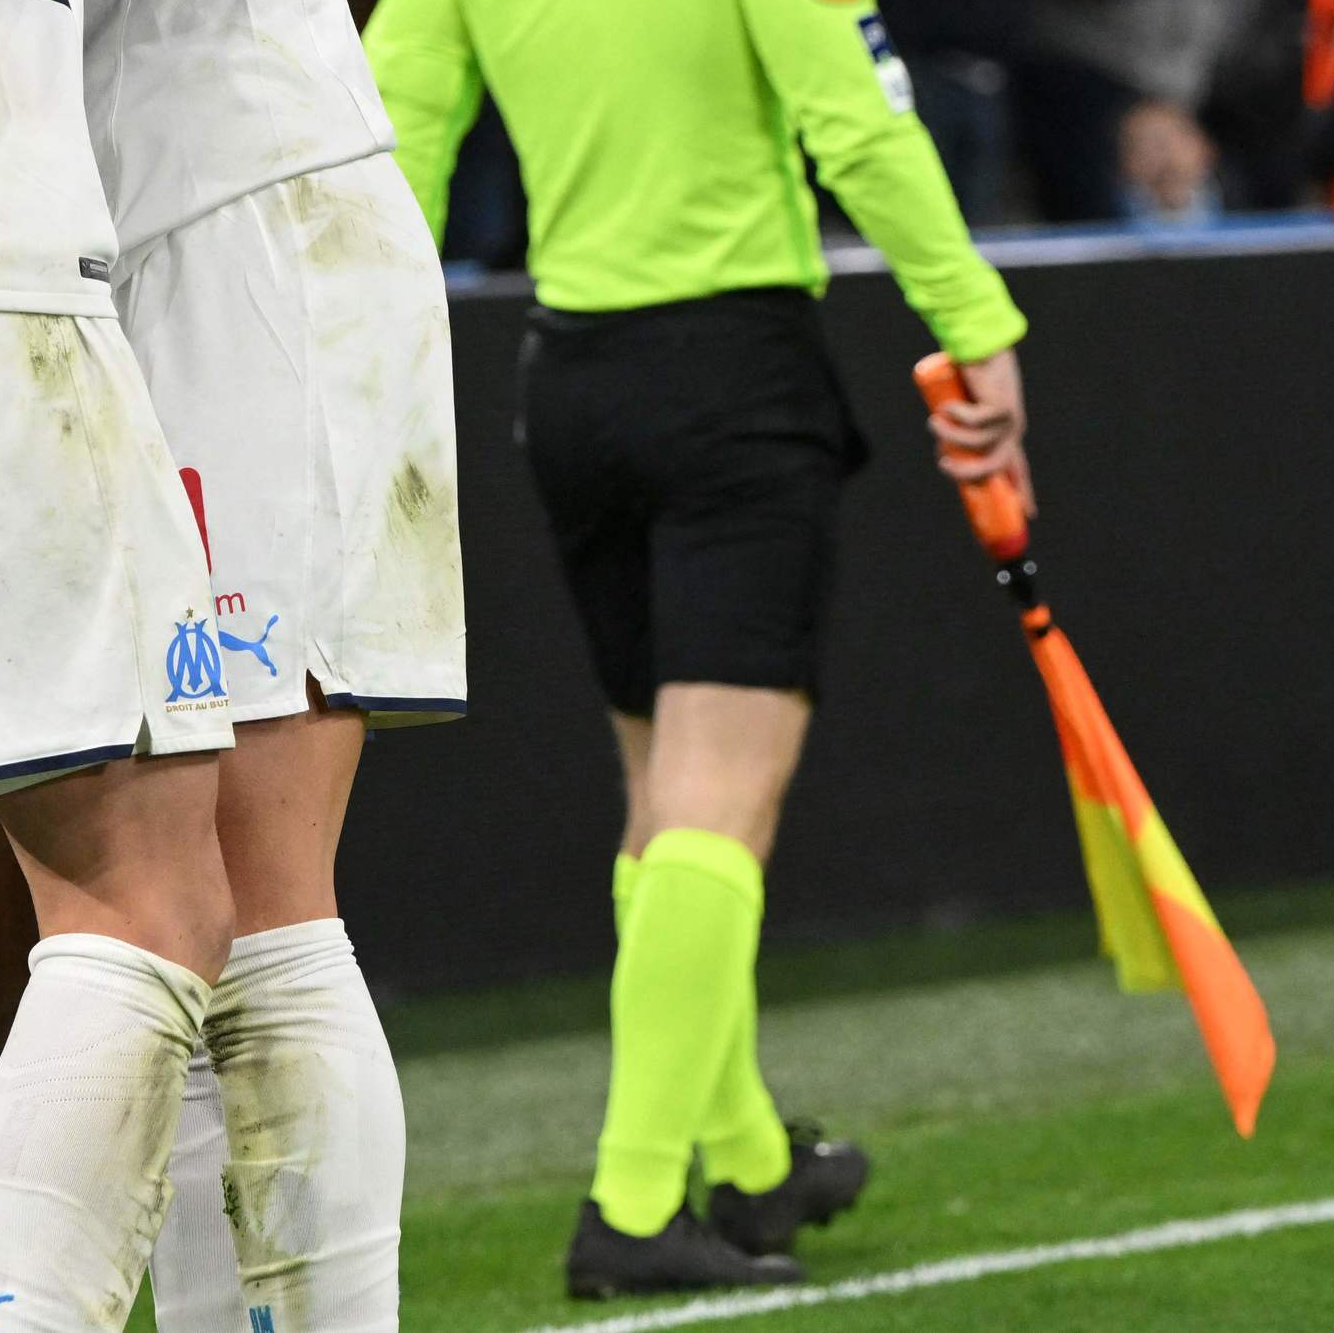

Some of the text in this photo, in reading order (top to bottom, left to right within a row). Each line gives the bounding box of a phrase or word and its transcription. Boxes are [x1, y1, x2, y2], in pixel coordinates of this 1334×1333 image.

[165, 698, 230, 713] DROIT AU BUT
